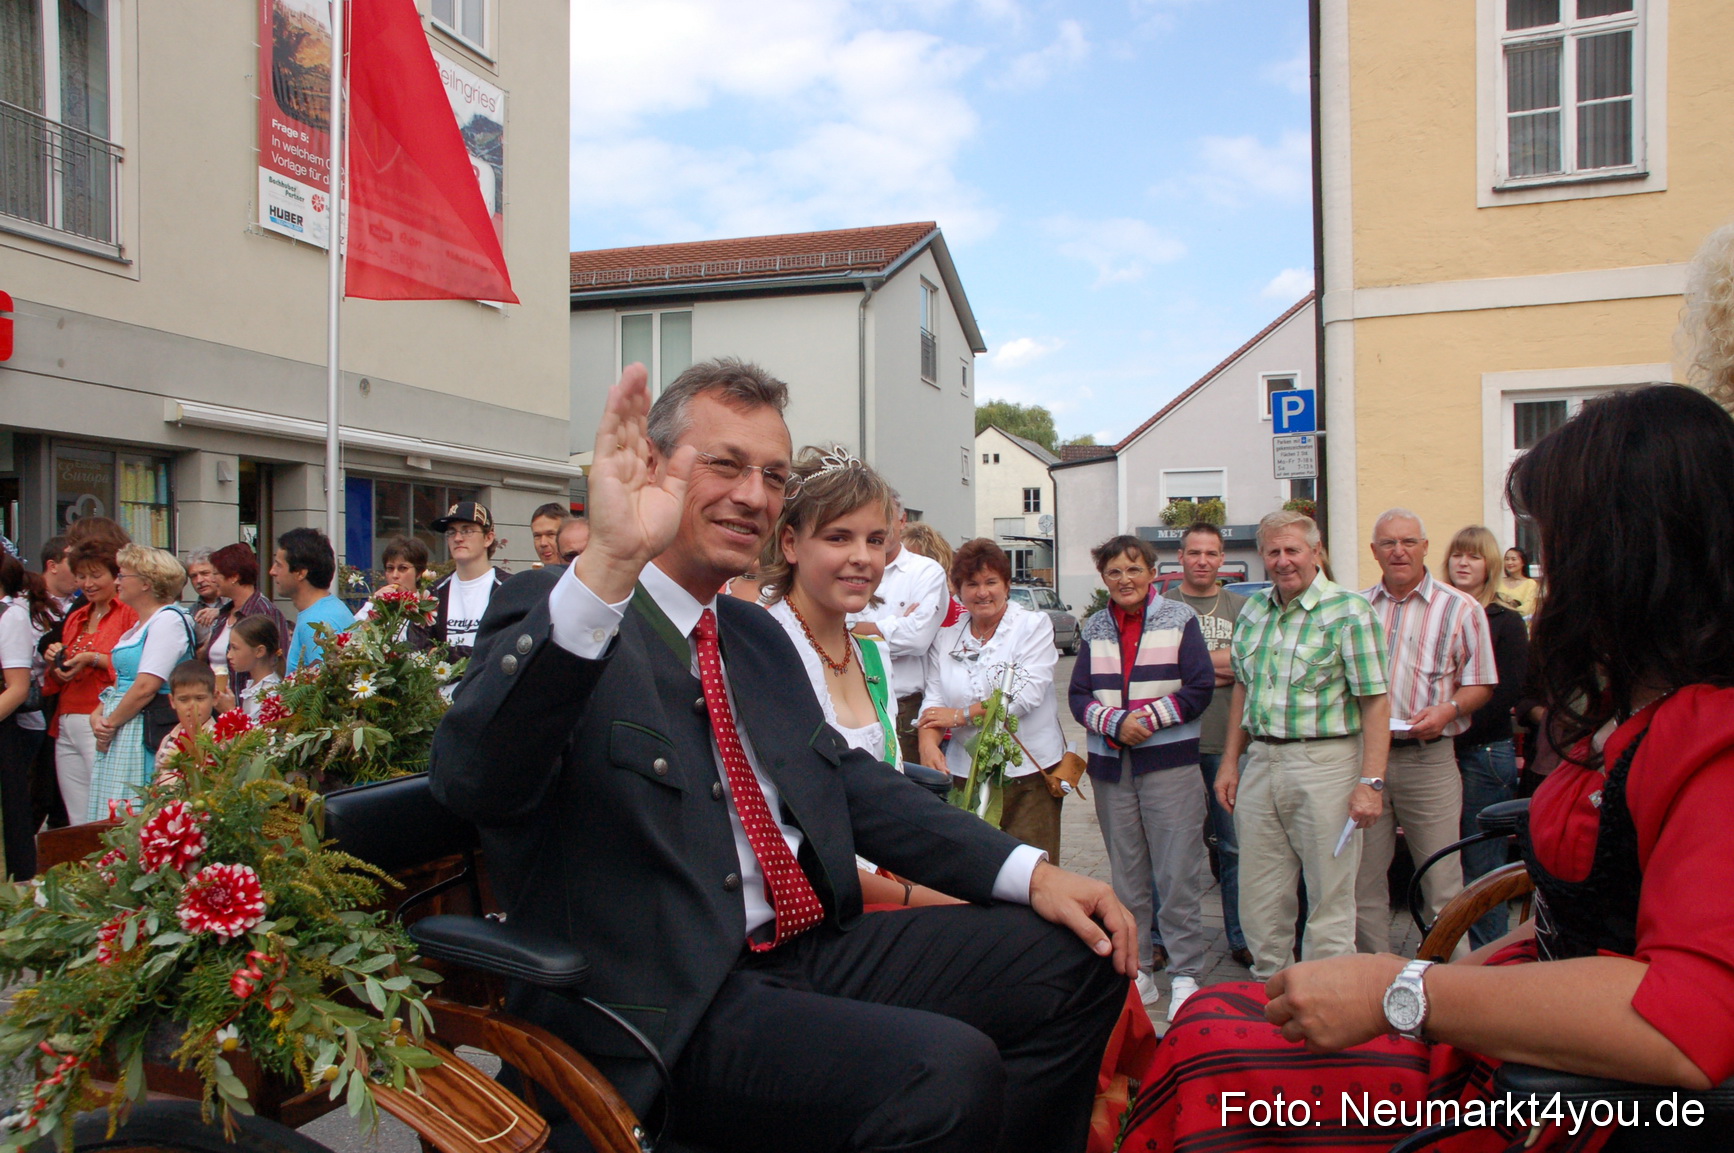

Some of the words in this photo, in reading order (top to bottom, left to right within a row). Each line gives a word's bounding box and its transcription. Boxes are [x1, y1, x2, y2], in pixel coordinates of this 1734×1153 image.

[271, 118, 298, 138] Frage
[300, 132, 309, 144] 5:
[271, 134, 280, 148] In
[282, 141, 324, 167] welchem
[271, 150, 307, 176] Vorlage
[309, 166, 321, 181] für
[285, 189, 305, 202] Partner
[269, 204, 303, 227] HUBER
[1282, 396, 1305, 429] P
[62, 463, 109, 488] Europa
[1158, 528, 1233, 538] METEI
